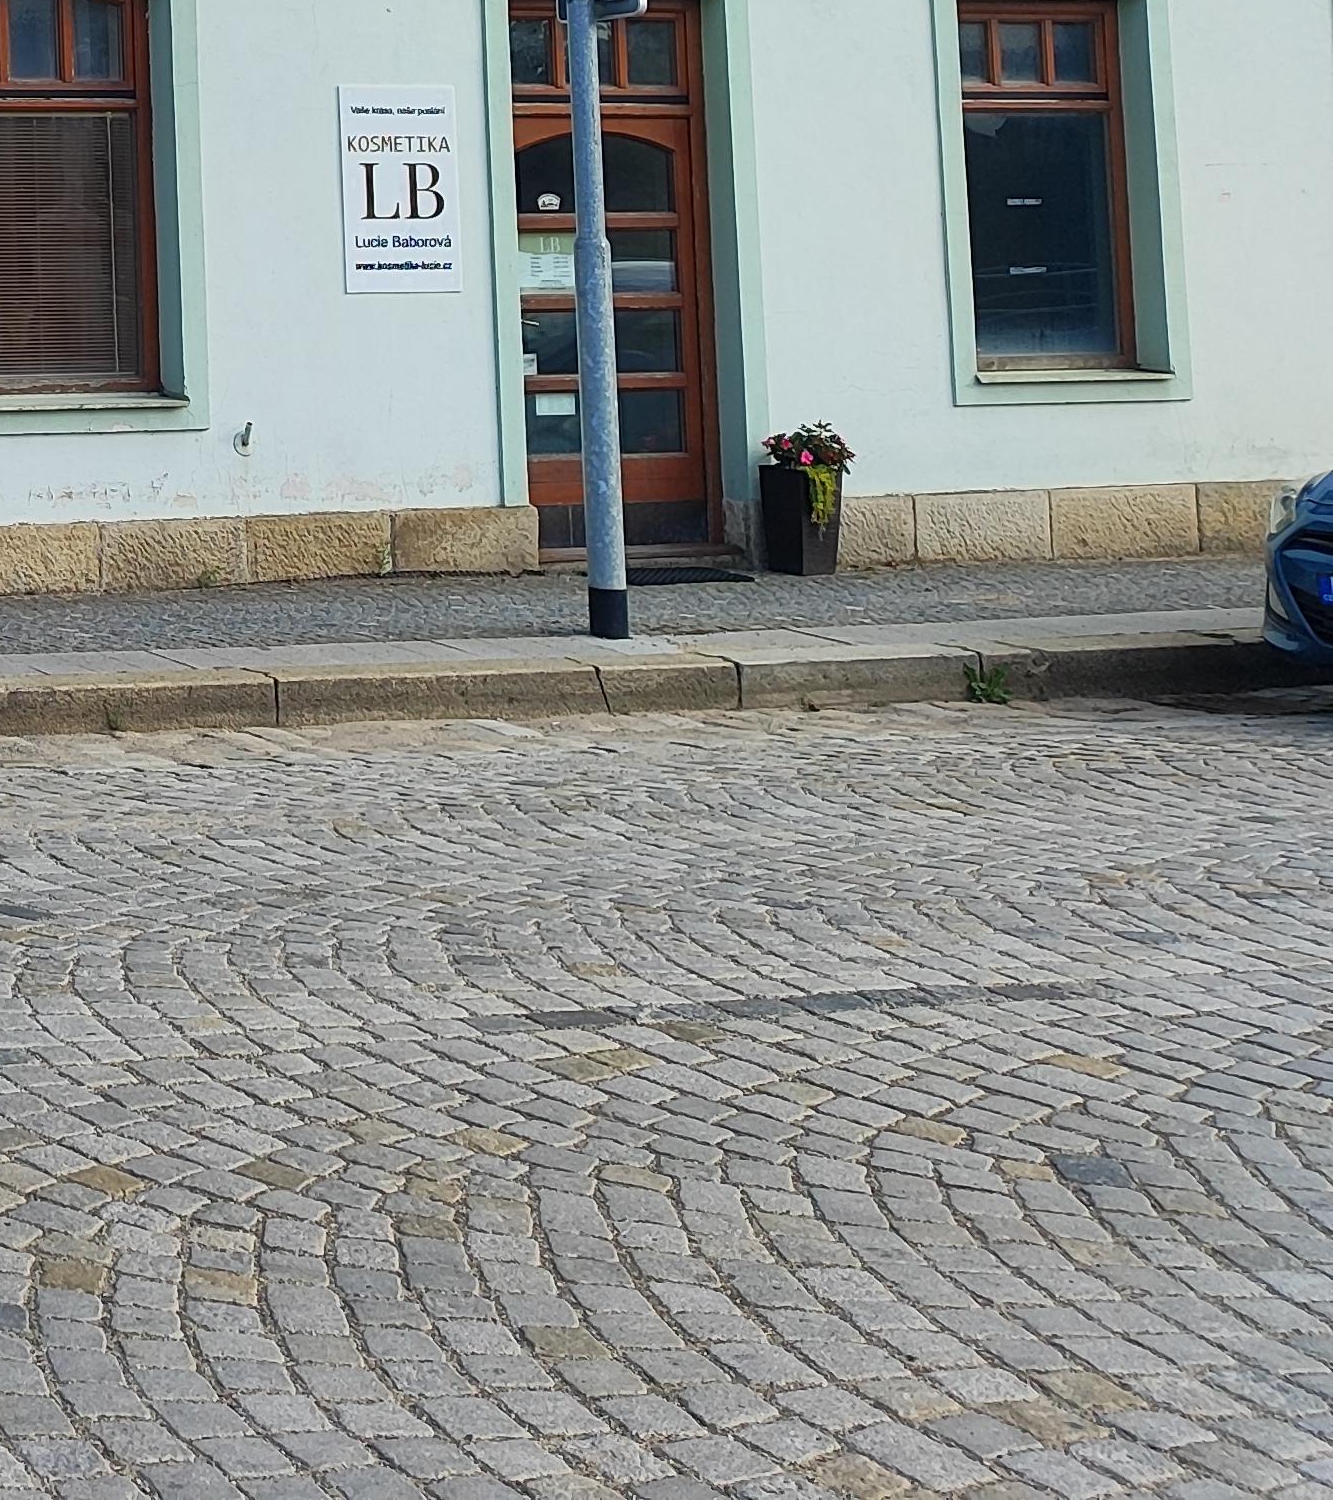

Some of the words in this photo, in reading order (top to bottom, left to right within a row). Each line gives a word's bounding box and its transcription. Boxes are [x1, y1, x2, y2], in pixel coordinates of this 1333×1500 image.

[347, 135, 451, 153] KOSMETIKA
[358, 162, 446, 220] LB
[355, 235, 389, 248] Lucie
[392, 235, 452, 248] Baborová
[539, 236, 561, 253] LB
